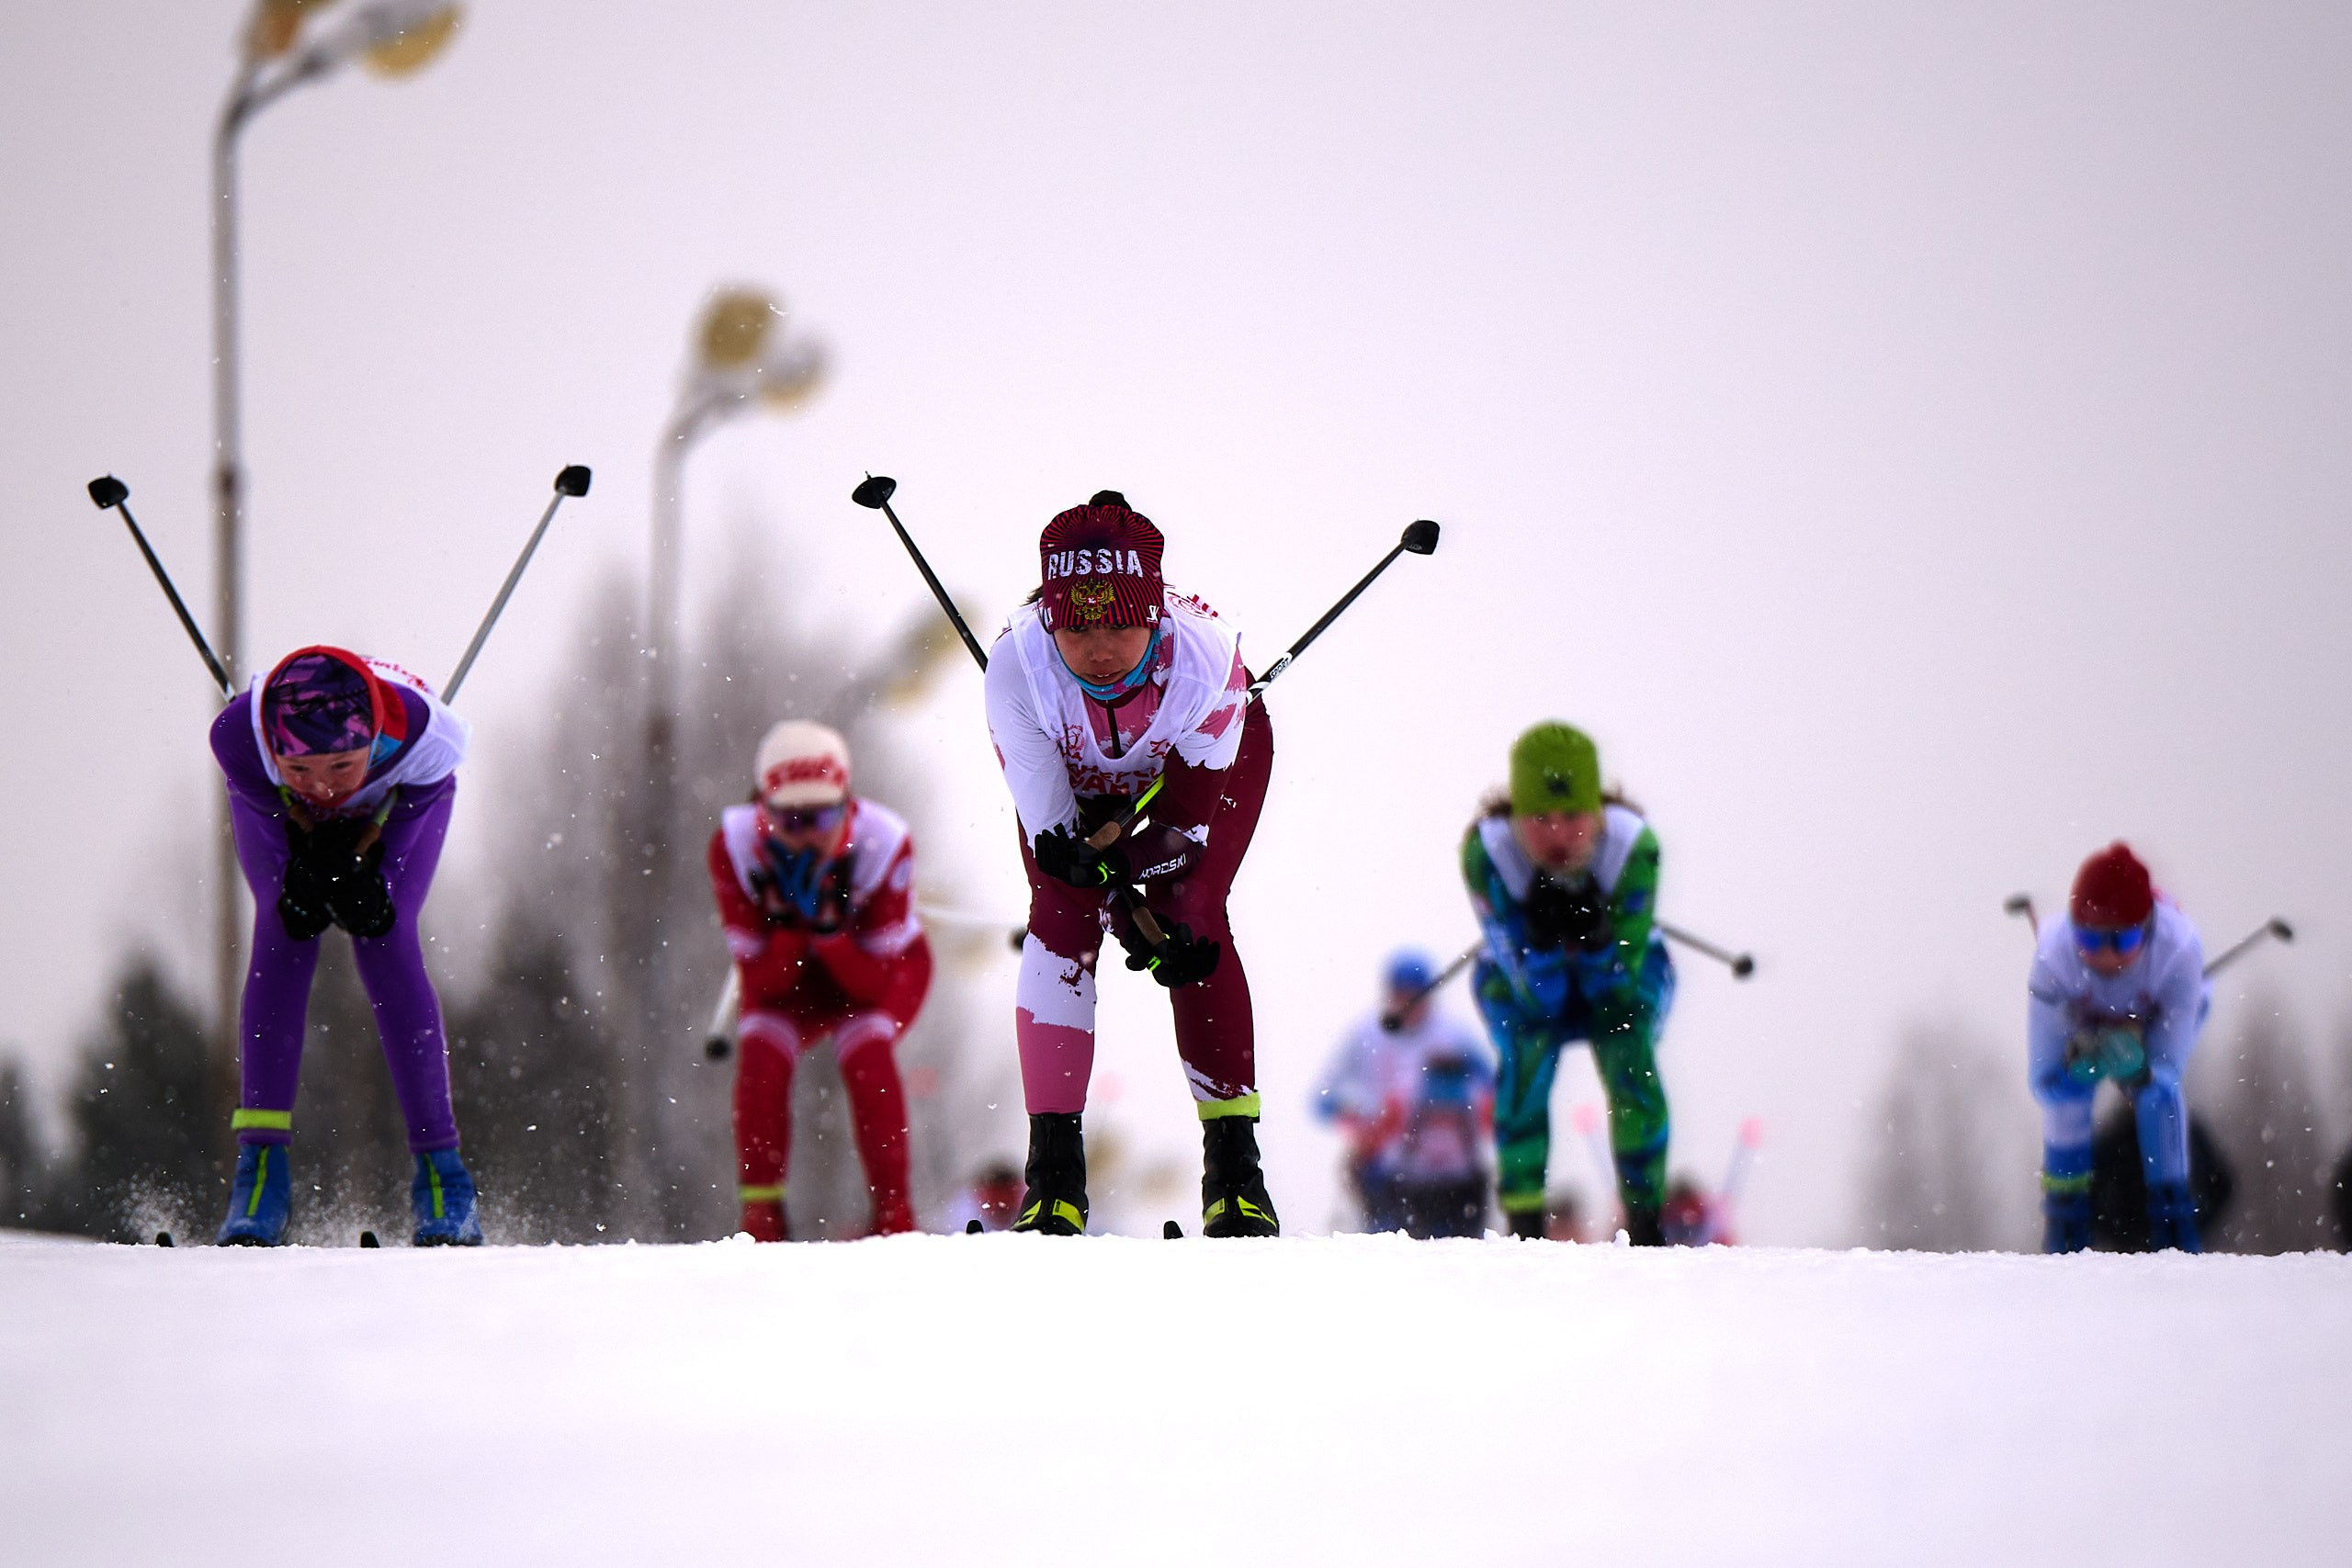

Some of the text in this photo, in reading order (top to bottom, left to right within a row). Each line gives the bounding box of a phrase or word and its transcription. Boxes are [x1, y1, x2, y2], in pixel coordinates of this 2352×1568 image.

[1047, 548, 1144, 580] RUSSIA
[1270, 657, 1290, 680] SPORT
[1138, 852, 1187, 880] NORDSKI
